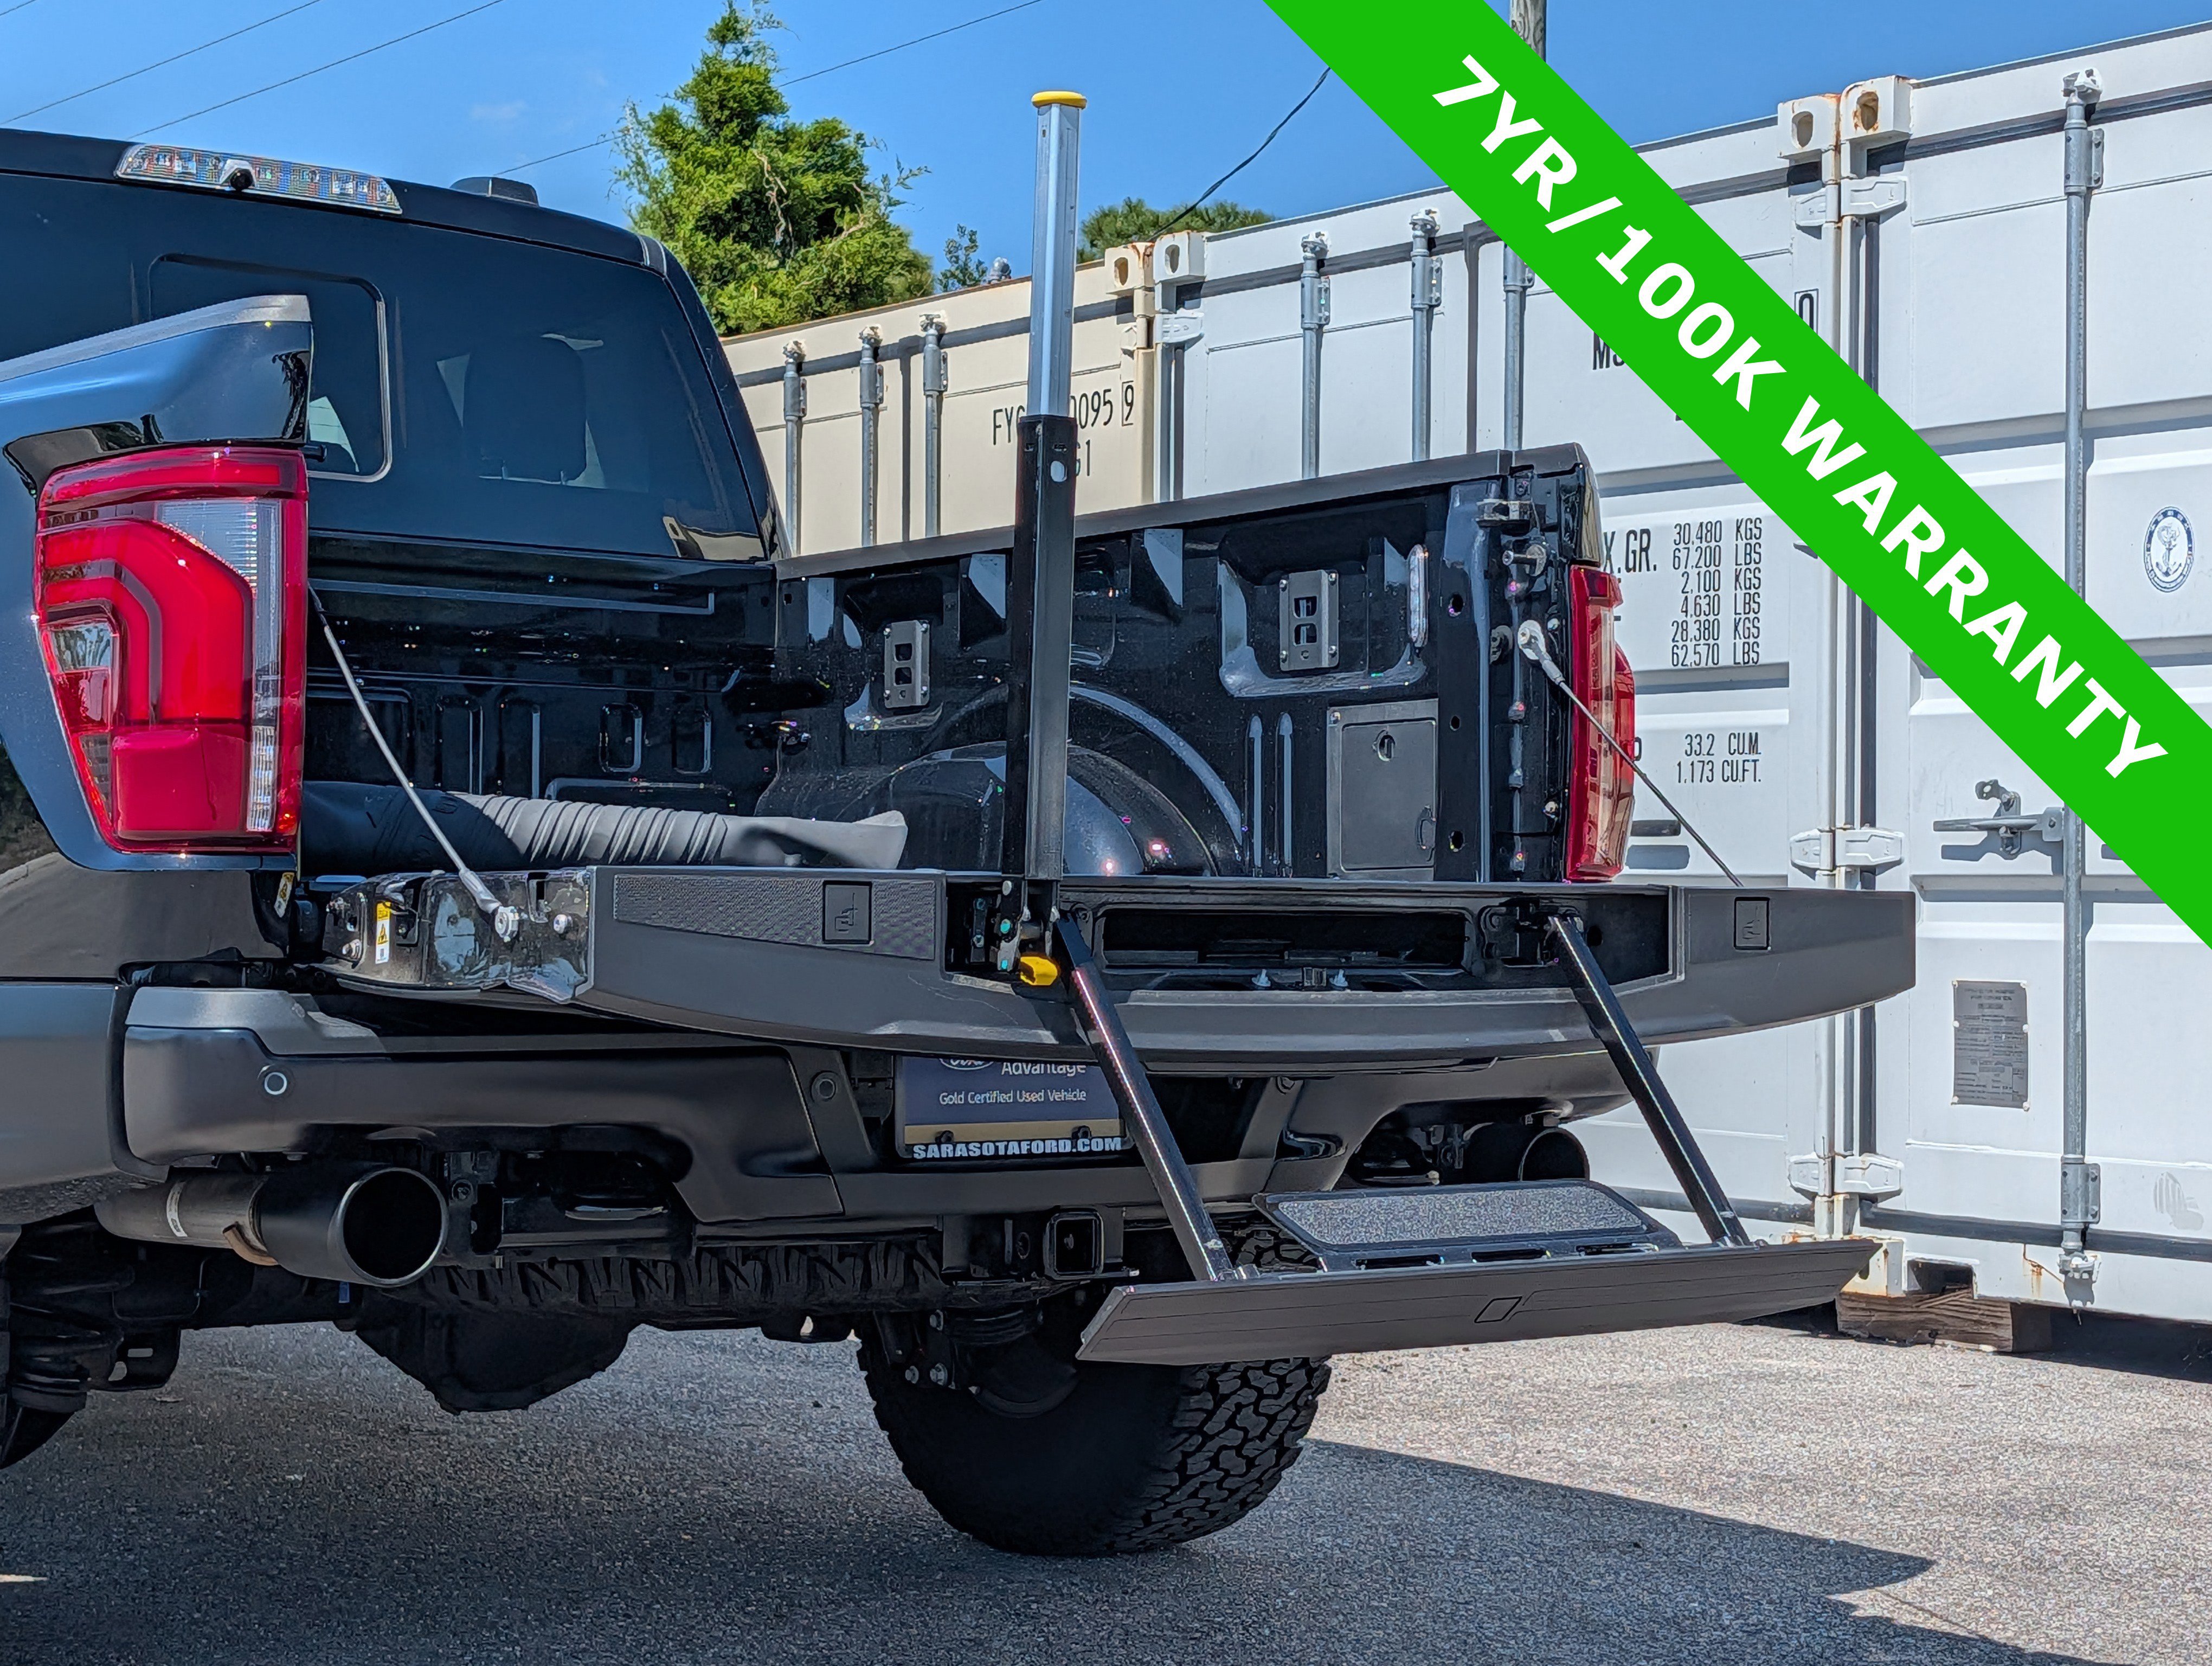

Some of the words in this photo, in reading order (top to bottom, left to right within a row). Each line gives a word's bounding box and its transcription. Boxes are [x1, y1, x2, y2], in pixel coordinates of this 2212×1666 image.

[1124, 385, 1135, 422] 9
[1735, 517, 1762, 542] KGS
[1735, 542, 1761, 566] LBS
[1734, 567, 1761, 591] KGS
[1734, 592, 1760, 616] LBS
[1733, 616, 1760, 640] KGS
[1733, 641, 1760, 665] LBS
[939, 1091, 965, 1105] Gold
[968, 1090, 1013, 1104] Certified
[1017, 1090, 1045, 1103] Used
[1047, 1088, 1087, 1101] Vehicle
[913, 1137, 1122, 1159] SARASOTAFORD.COM
